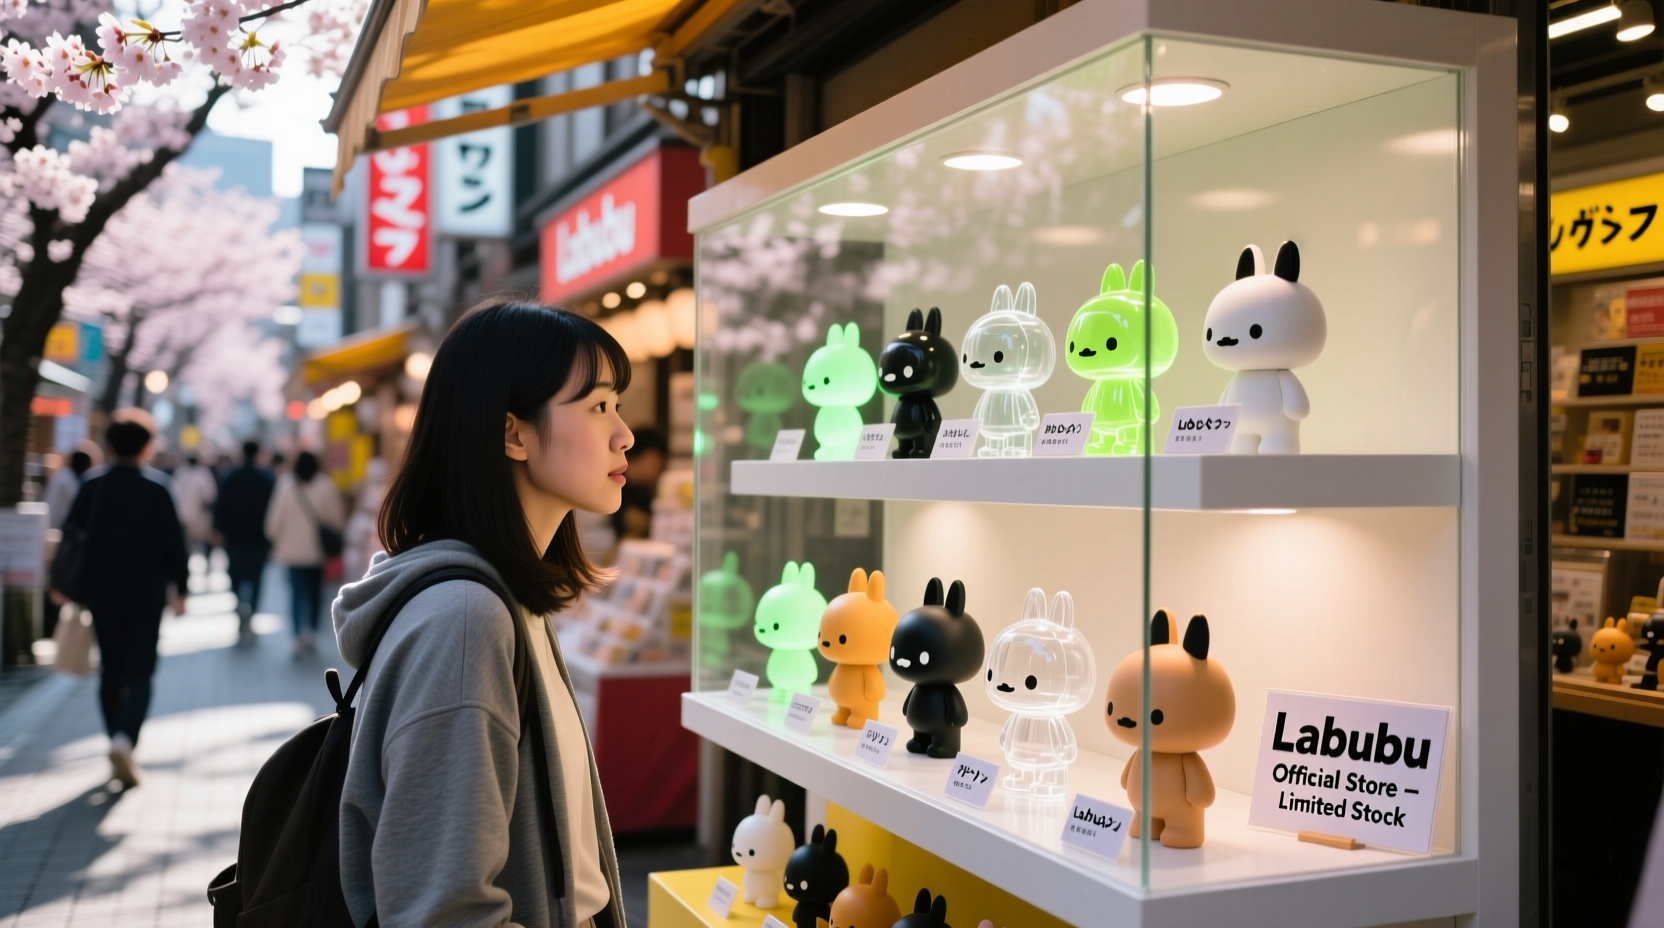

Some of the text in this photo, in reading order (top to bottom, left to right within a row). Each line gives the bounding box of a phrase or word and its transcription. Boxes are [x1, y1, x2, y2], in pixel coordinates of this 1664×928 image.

[1272, 711, 1431, 770] Labubu
[1272, 763, 1341, 790] Official
[1345, 772, 1398, 797] Store
[1278, 790, 1406, 828] Limited Stock
